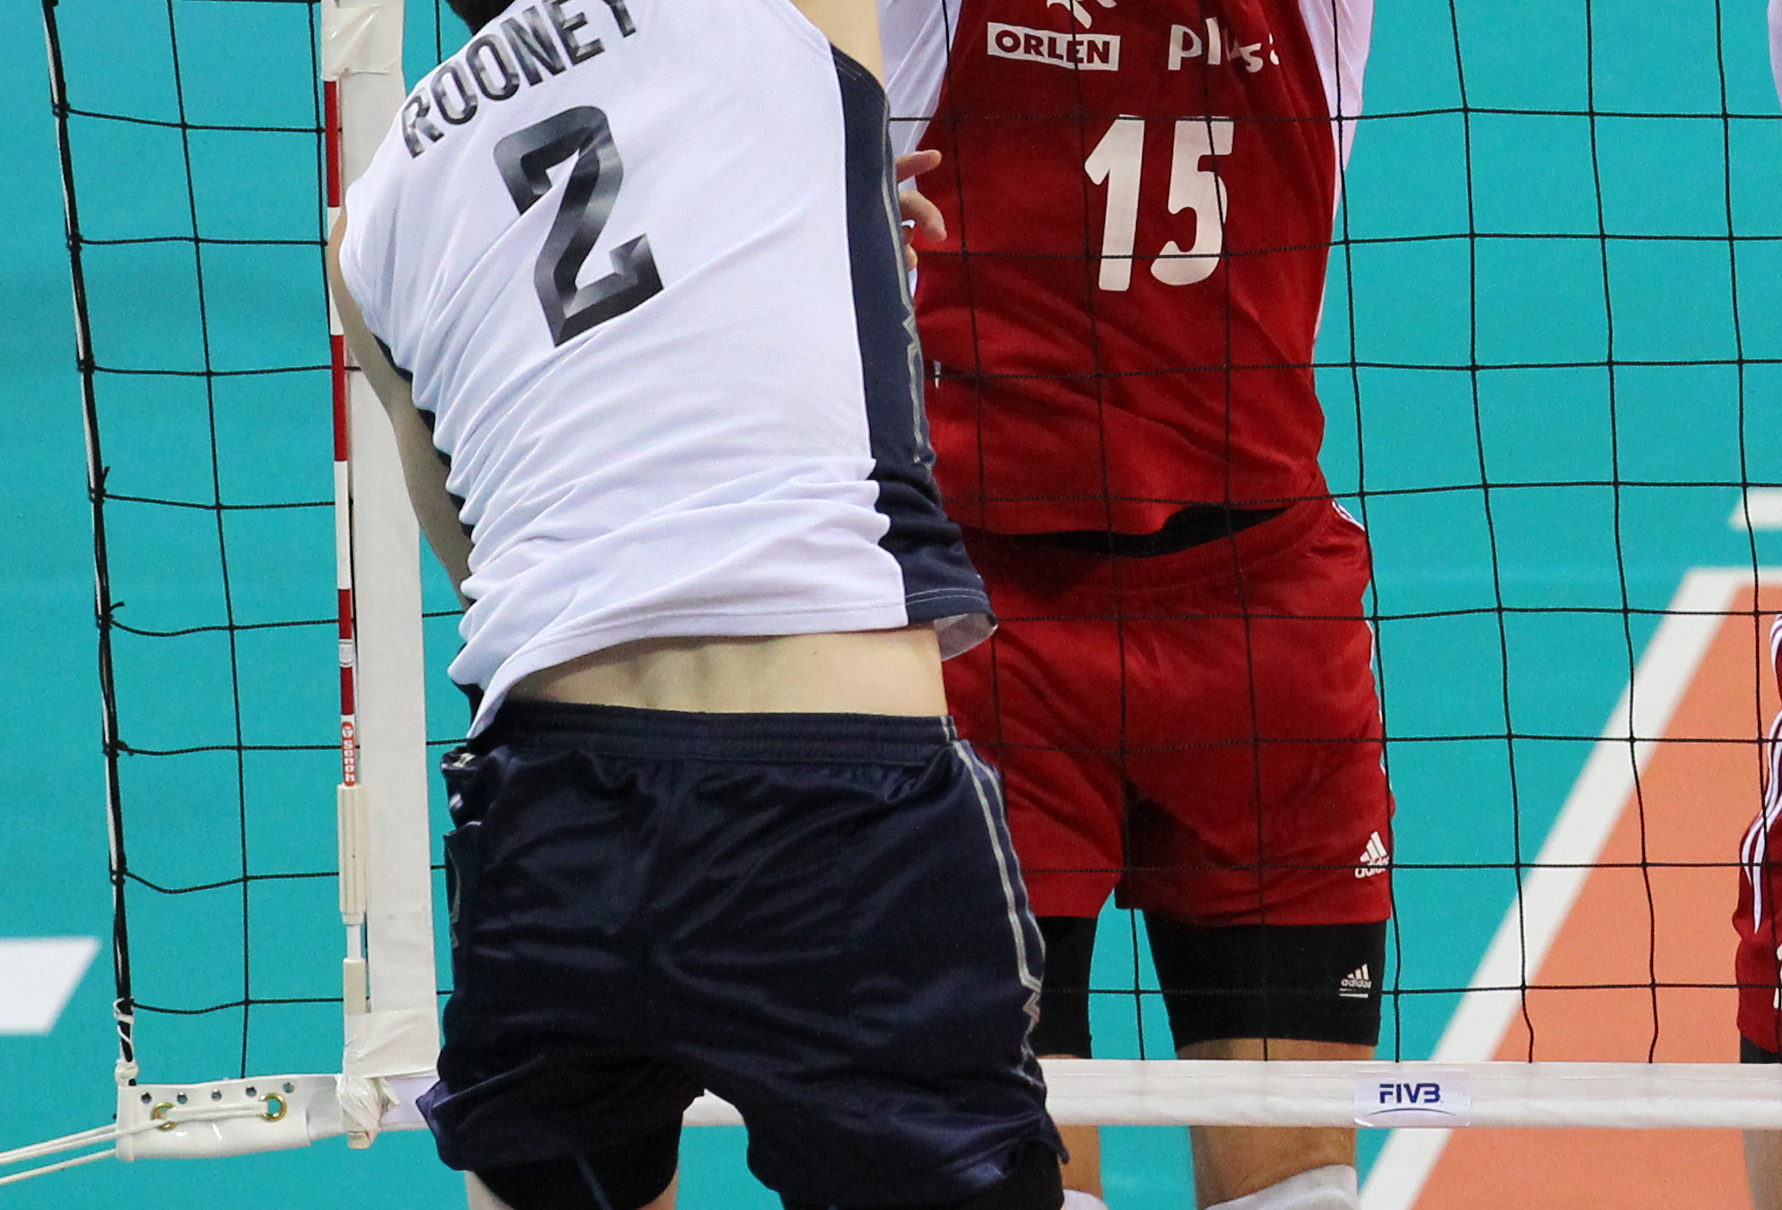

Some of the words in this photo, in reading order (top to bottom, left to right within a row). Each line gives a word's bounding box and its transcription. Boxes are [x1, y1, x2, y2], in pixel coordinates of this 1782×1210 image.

[995, 29, 1111, 64] ORLEN
[493, 105, 664, 347] 2
[1083, 114, 1235, 292] 15
[1379, 1083, 1440, 1105] FIVB
